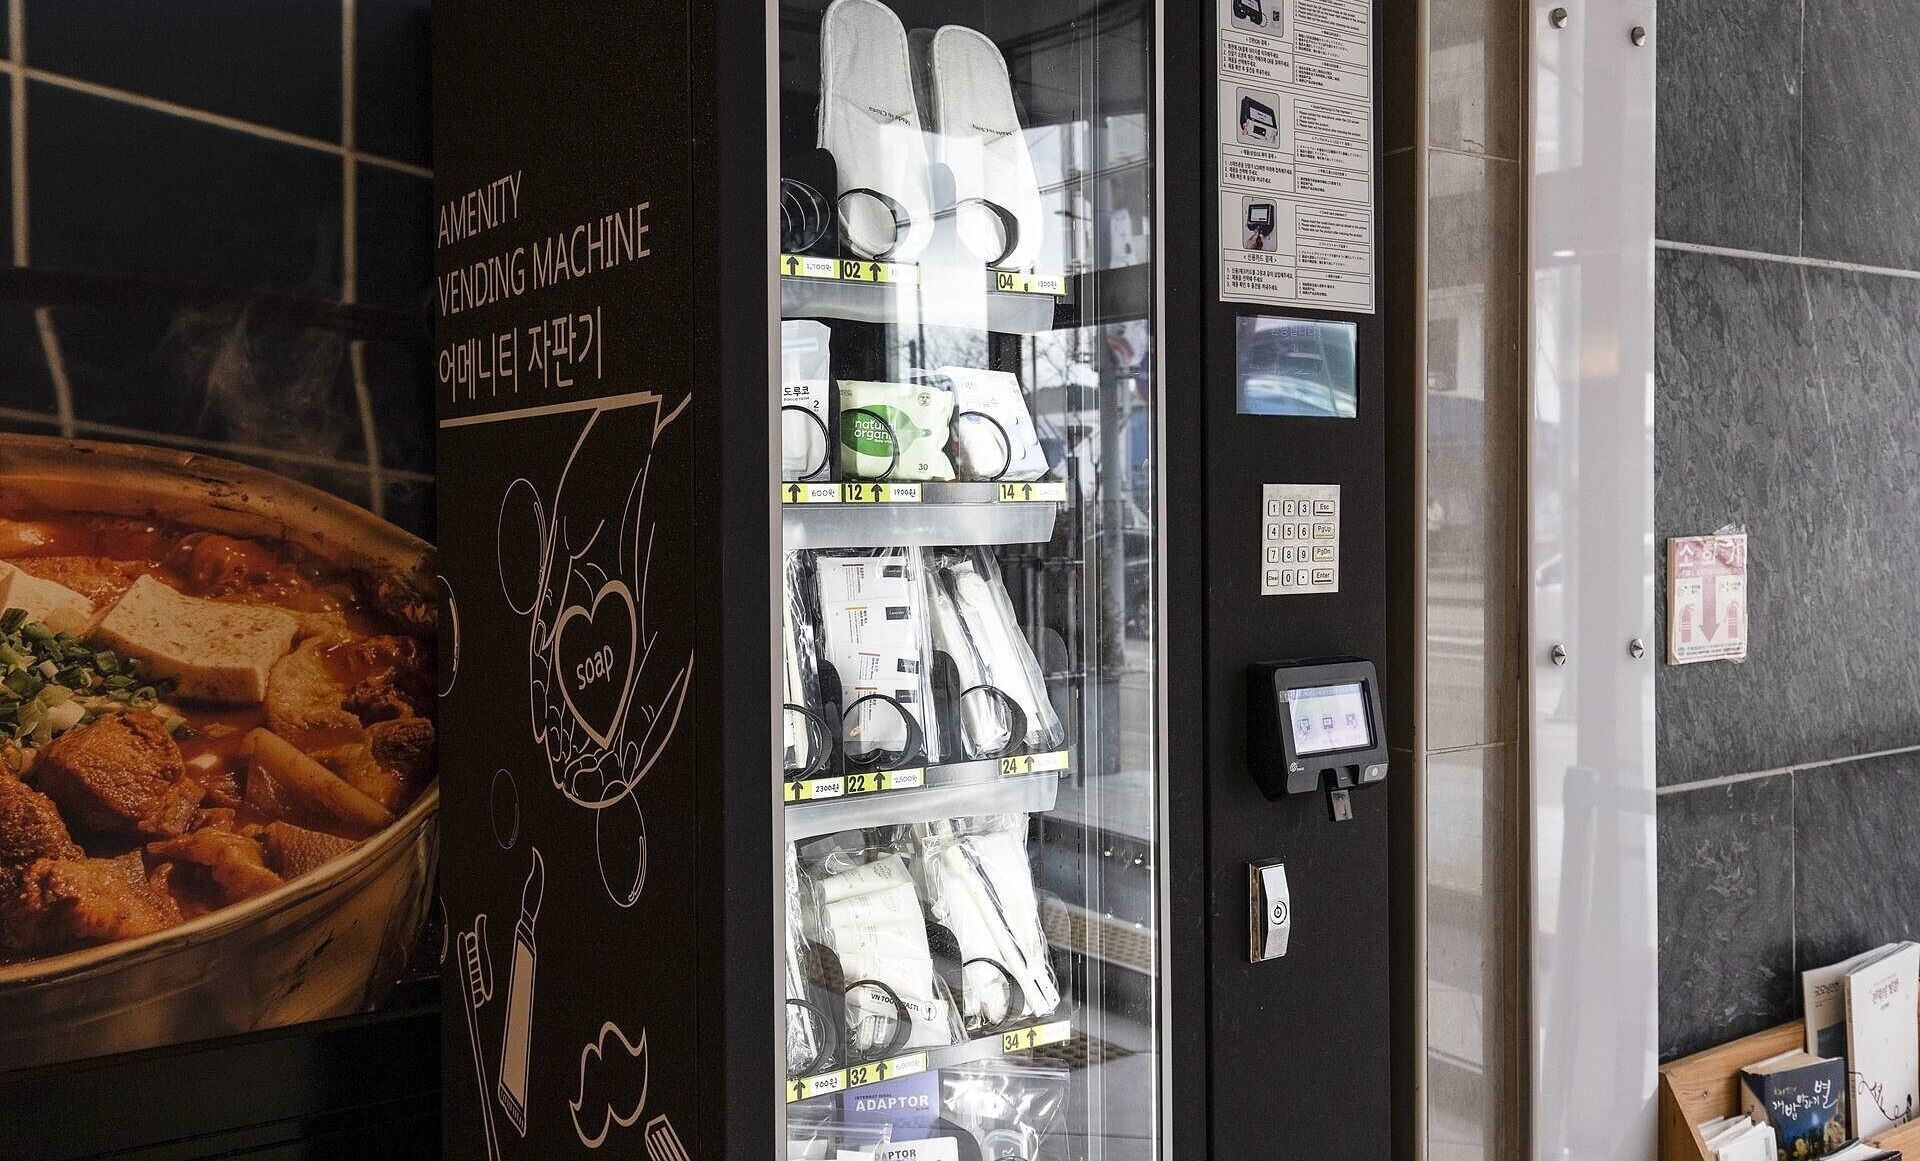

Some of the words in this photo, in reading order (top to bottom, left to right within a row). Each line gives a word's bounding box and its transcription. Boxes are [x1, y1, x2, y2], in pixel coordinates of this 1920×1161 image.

[438, 170, 522, 249] AMENITY
[438, 247, 525, 317] VENDING
[533, 202, 650, 290] MACHINE
[844, 261, 861, 279] 02
[999, 273, 1013, 290] 04
[439, 327, 518, 403] 어메니티
[528, 306, 601, 388] 자판기
[783, 385, 810, 397] 도루코
[813, 399, 820, 409] 2
[918, 463, 929, 471] 30
[847, 484, 863, 501] 12
[1001, 484, 1015, 500] 14
[1271, 527, 1277, 536] 4
[1286, 527, 1292, 536] 5
[1301, 527, 1307, 536] 6
[1286, 550, 1292, 559] 8
[1301, 550, 1306, 559] 9
[1285, 573, 1291, 582] 0
[576, 645, 614, 690] soap
[1002, 758, 1017, 775] 24
[848, 775, 865, 793] 22
[871, 993, 881, 1001] VN
[1005, 1033, 1019, 1050] 34
[851, 1067, 867, 1085] 32
[1814, 1079, 1839, 1109] 별
[855, 1095, 929, 1112] ADAPTOR
